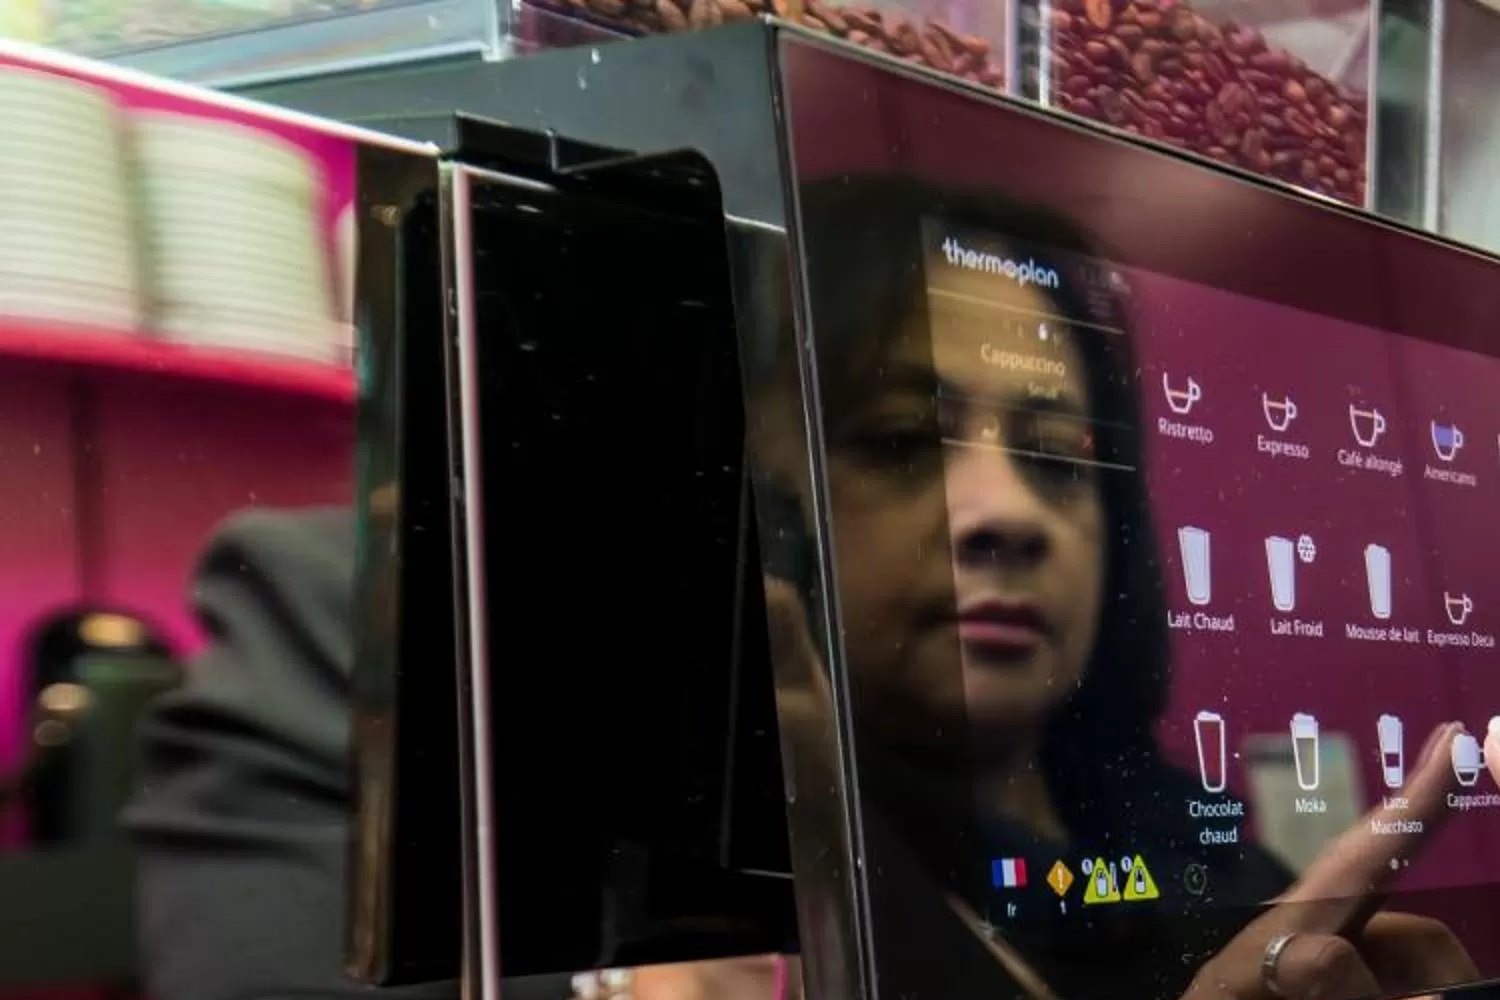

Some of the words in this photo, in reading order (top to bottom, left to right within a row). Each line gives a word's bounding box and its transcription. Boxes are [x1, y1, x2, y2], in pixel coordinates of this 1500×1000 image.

[942, 237, 1059, 287] thermoplan
[980, 343, 1066, 377] Cappuccino
[1158, 417, 1214, 445] Ristretto
[1257, 434, 1310, 459] Expresso
[1338, 448, 1363, 468] Café
[1424, 463, 1477, 487] Americano
[1167, 610, 1192, 629] Lait
[1194, 613, 1235, 631] Chaud
[1270, 618, 1293, 635] Lait
[1294, 619, 1324, 637] Froid
[1345, 623, 1387, 641] Mousse
[1388, 627, 1403, 641] de
[1403, 627, 1420, 643] lait
[1427, 629, 1470, 647] Expresso
[1189, 800, 1245, 818] Chocolat
[1295, 798, 1327, 813] Moka
[1447, 793, 1500, 811] Cappuccino
[1200, 826, 1239, 845] chaud
[1370, 818, 1423, 835] Macchiato
